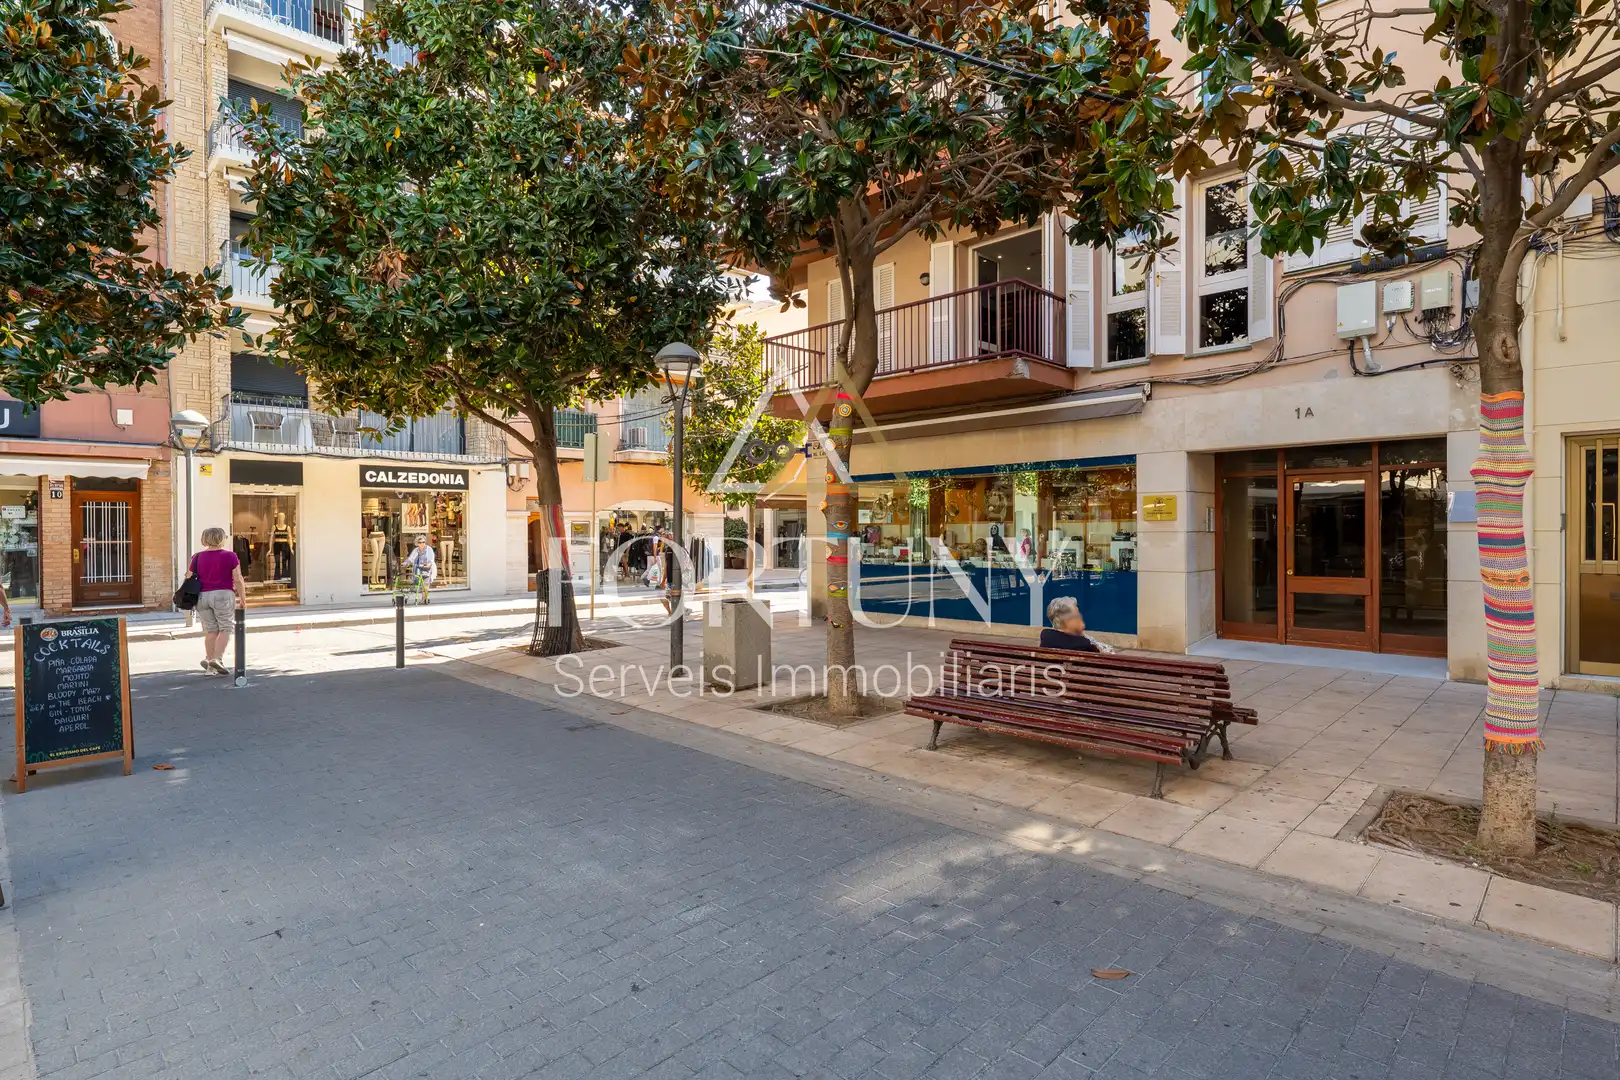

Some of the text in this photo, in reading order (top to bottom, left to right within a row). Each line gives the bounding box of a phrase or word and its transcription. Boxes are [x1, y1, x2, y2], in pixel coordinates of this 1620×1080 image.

[365, 470, 465, 486] CALZEDONIA
[51, 489, 63, 499] 10
[61, 628, 99, 637] BRASILIA
[34, 638, 110, 662] COCKTAILS
[48, 658, 65, 670] PIÑA
[56, 665, 94, 675] MARGARITA
[63, 673, 89, 682] MOJITO
[57, 681, 89, 690] MARTINI
[48, 687, 101, 700] BLOODY MARY
[78, 695, 102, 705] BEACH
[49, 709, 63, 718] GIN
[70, 704, 92, 714] TONIC
[54, 714, 89, 725] DAIQUIRI
[59, 723, 89, 732] APEROL
